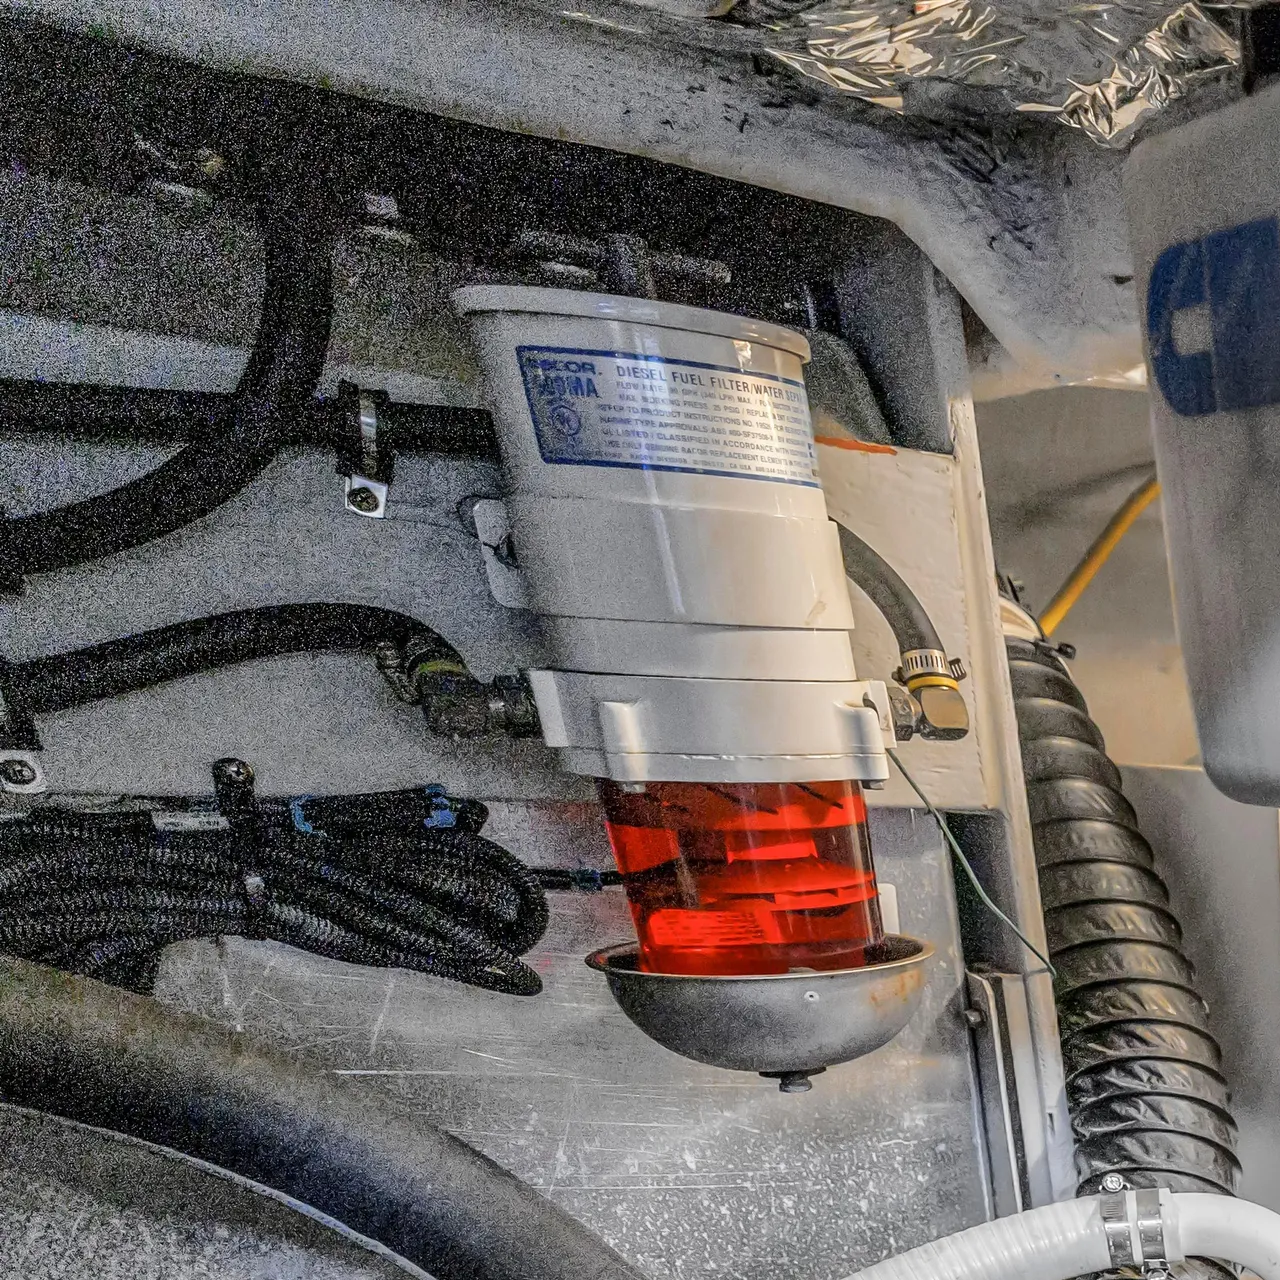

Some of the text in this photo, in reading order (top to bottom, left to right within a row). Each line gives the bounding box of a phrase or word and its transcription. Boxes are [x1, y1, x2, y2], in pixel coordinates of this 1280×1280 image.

[616, 364, 785, 400] DIESEL FUEL FILTER/WATER
[681, 411, 740, 427] INSTRUCTIONS
[658, 420, 716, 435] APPROVALS
[655, 431, 709, 446] CLASSIFIED
[721, 439, 772, 454] ACCORDANCE
[708, 448, 760, 463] REPLACEMENT
